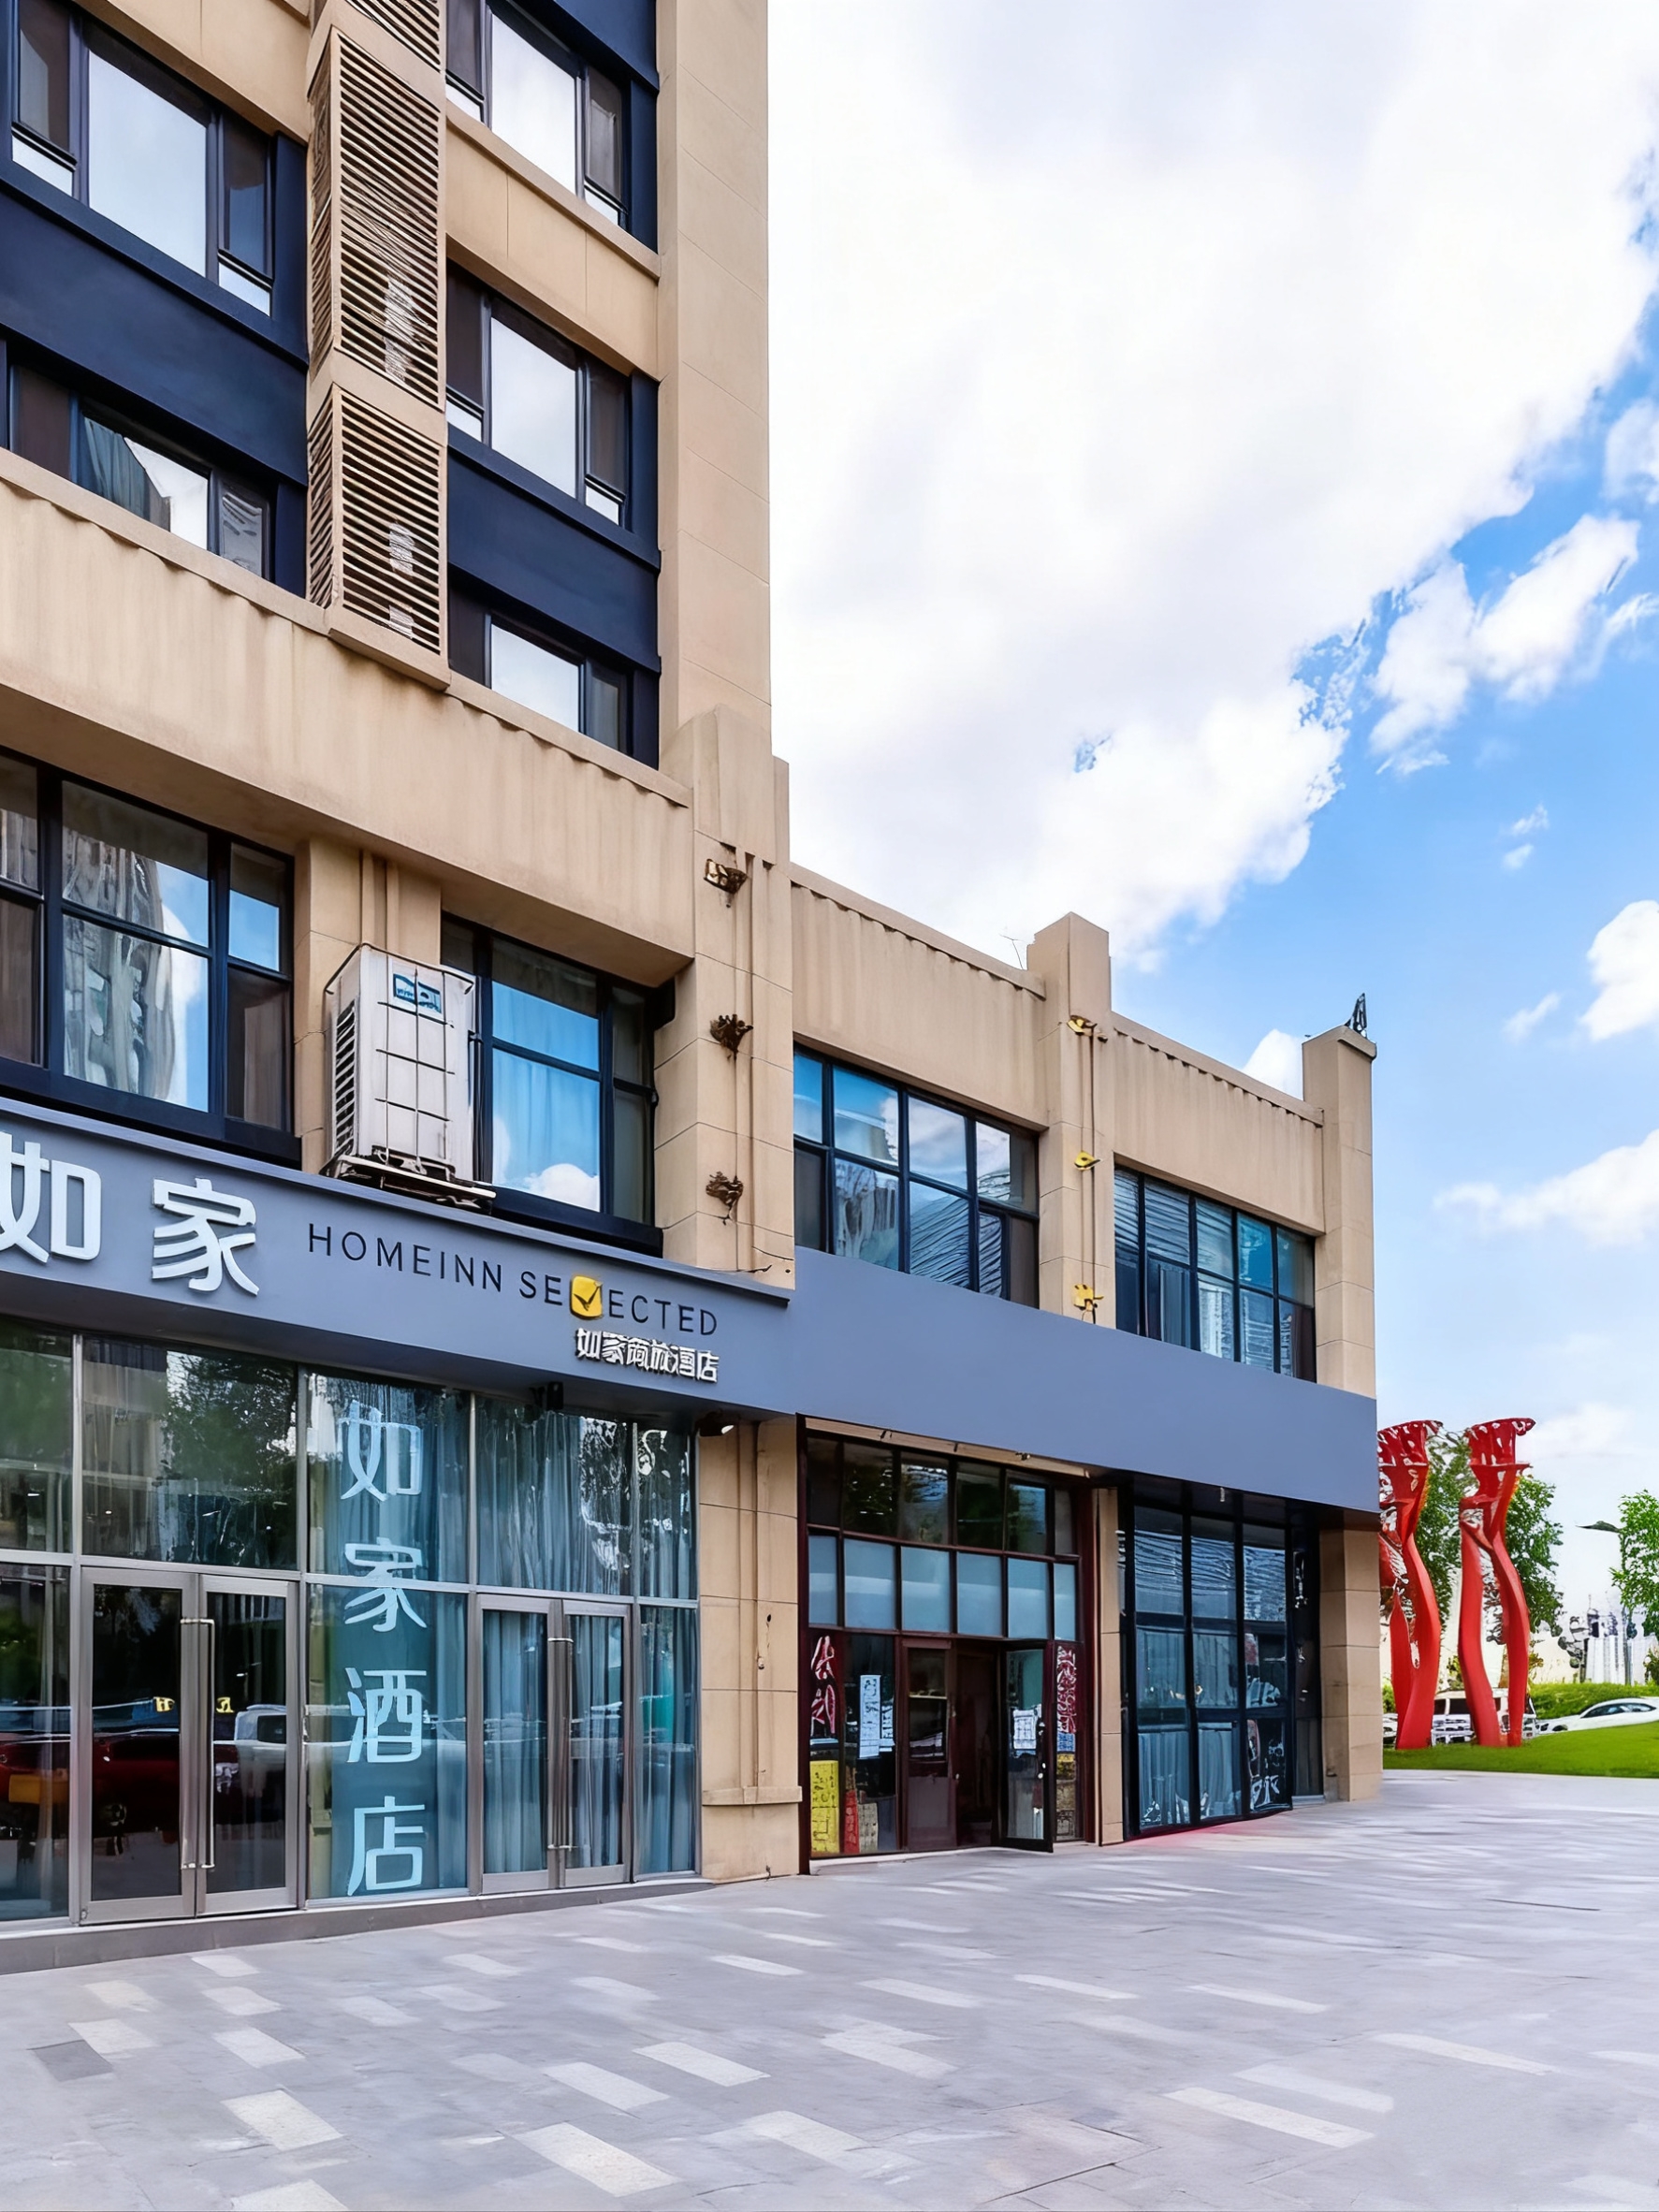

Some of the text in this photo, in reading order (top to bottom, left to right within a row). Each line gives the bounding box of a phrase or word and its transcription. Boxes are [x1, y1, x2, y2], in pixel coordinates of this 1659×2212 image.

[0, 1130, 260, 1297] 如家
[309, 1223, 718, 1336] HOMEINN SEECTED
[338, 1400, 428, 1897] 如家酒店
